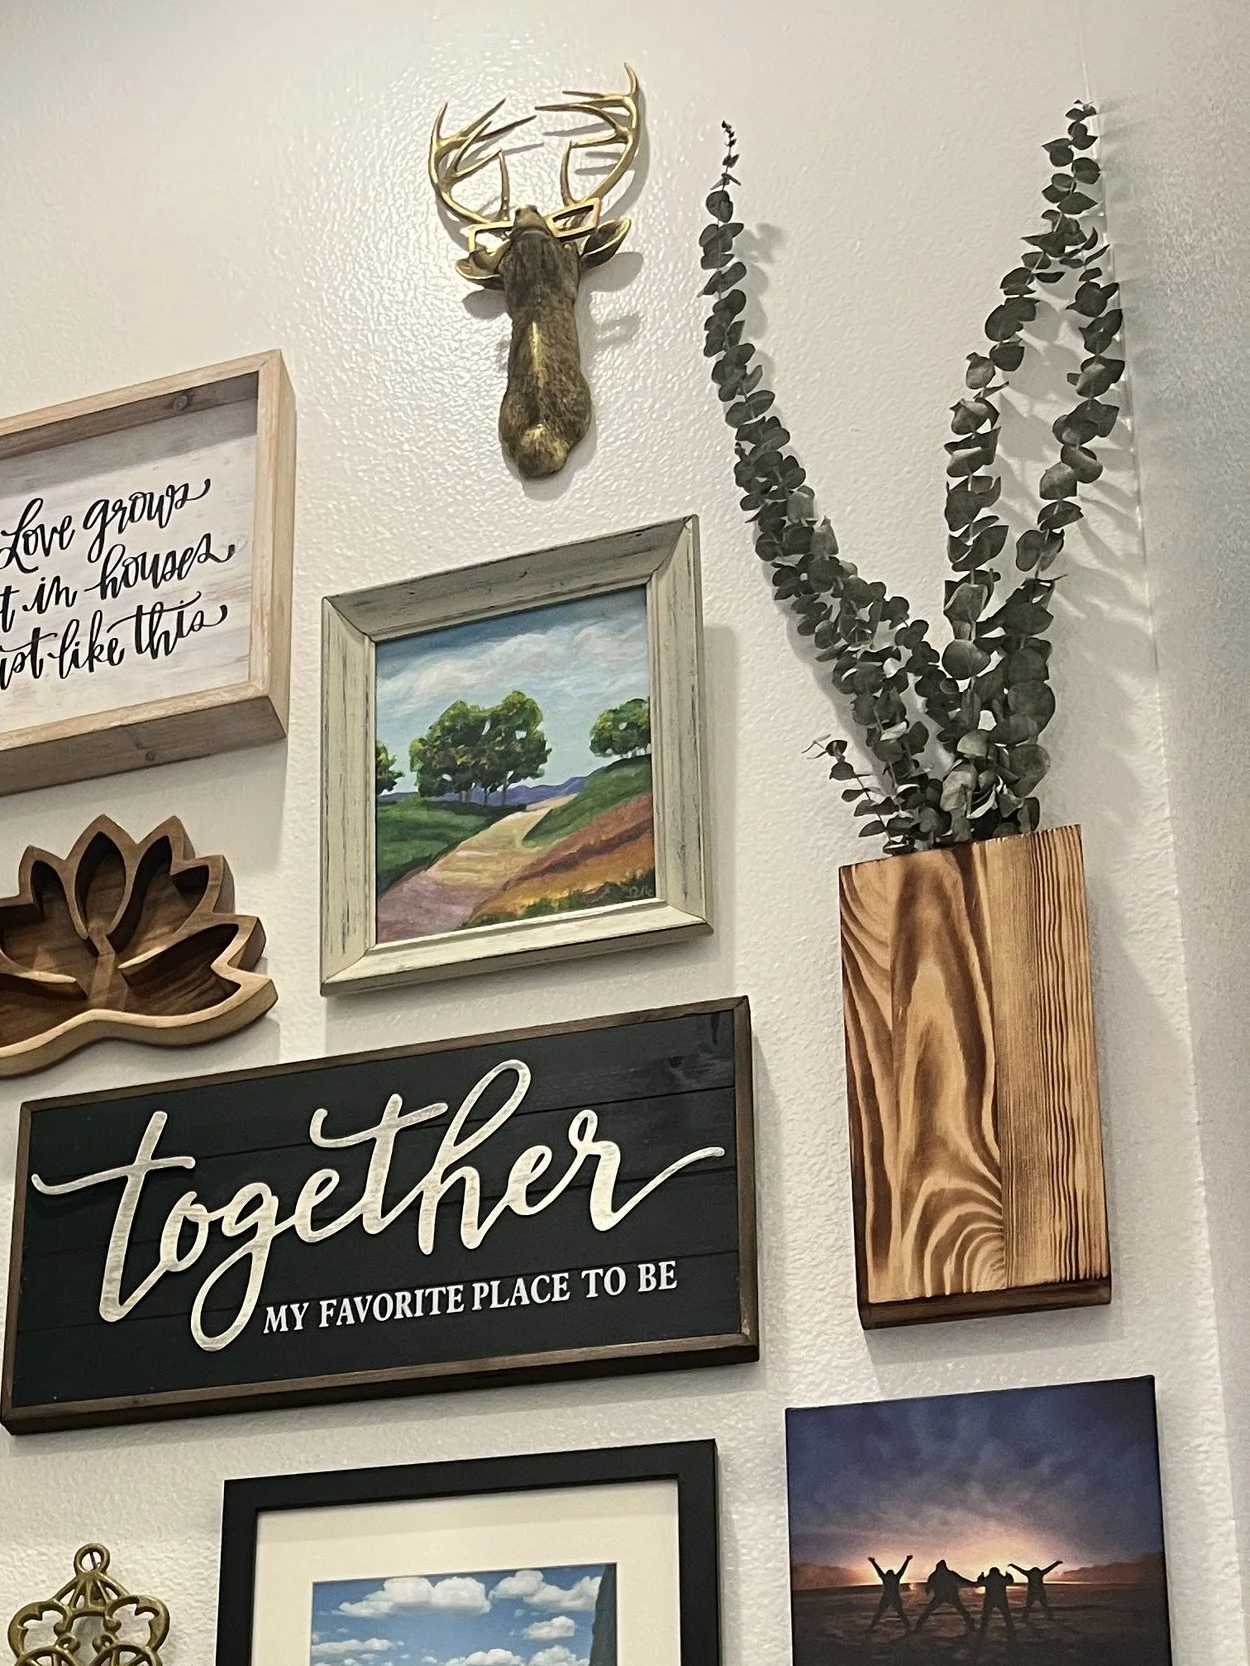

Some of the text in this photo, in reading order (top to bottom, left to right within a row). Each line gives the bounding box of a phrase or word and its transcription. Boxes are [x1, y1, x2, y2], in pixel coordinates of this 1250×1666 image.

[83, 478, 211, 562] grows
[22, 576, 77, 614] in
[84, 533, 235, 600] houses
[47, 610, 125, 678] like
[106, 591, 228, 660] this
[31, 1059, 725, 1351] together
[262, 1260, 678, 1334] MY FAVORITE PLACE TO BE
